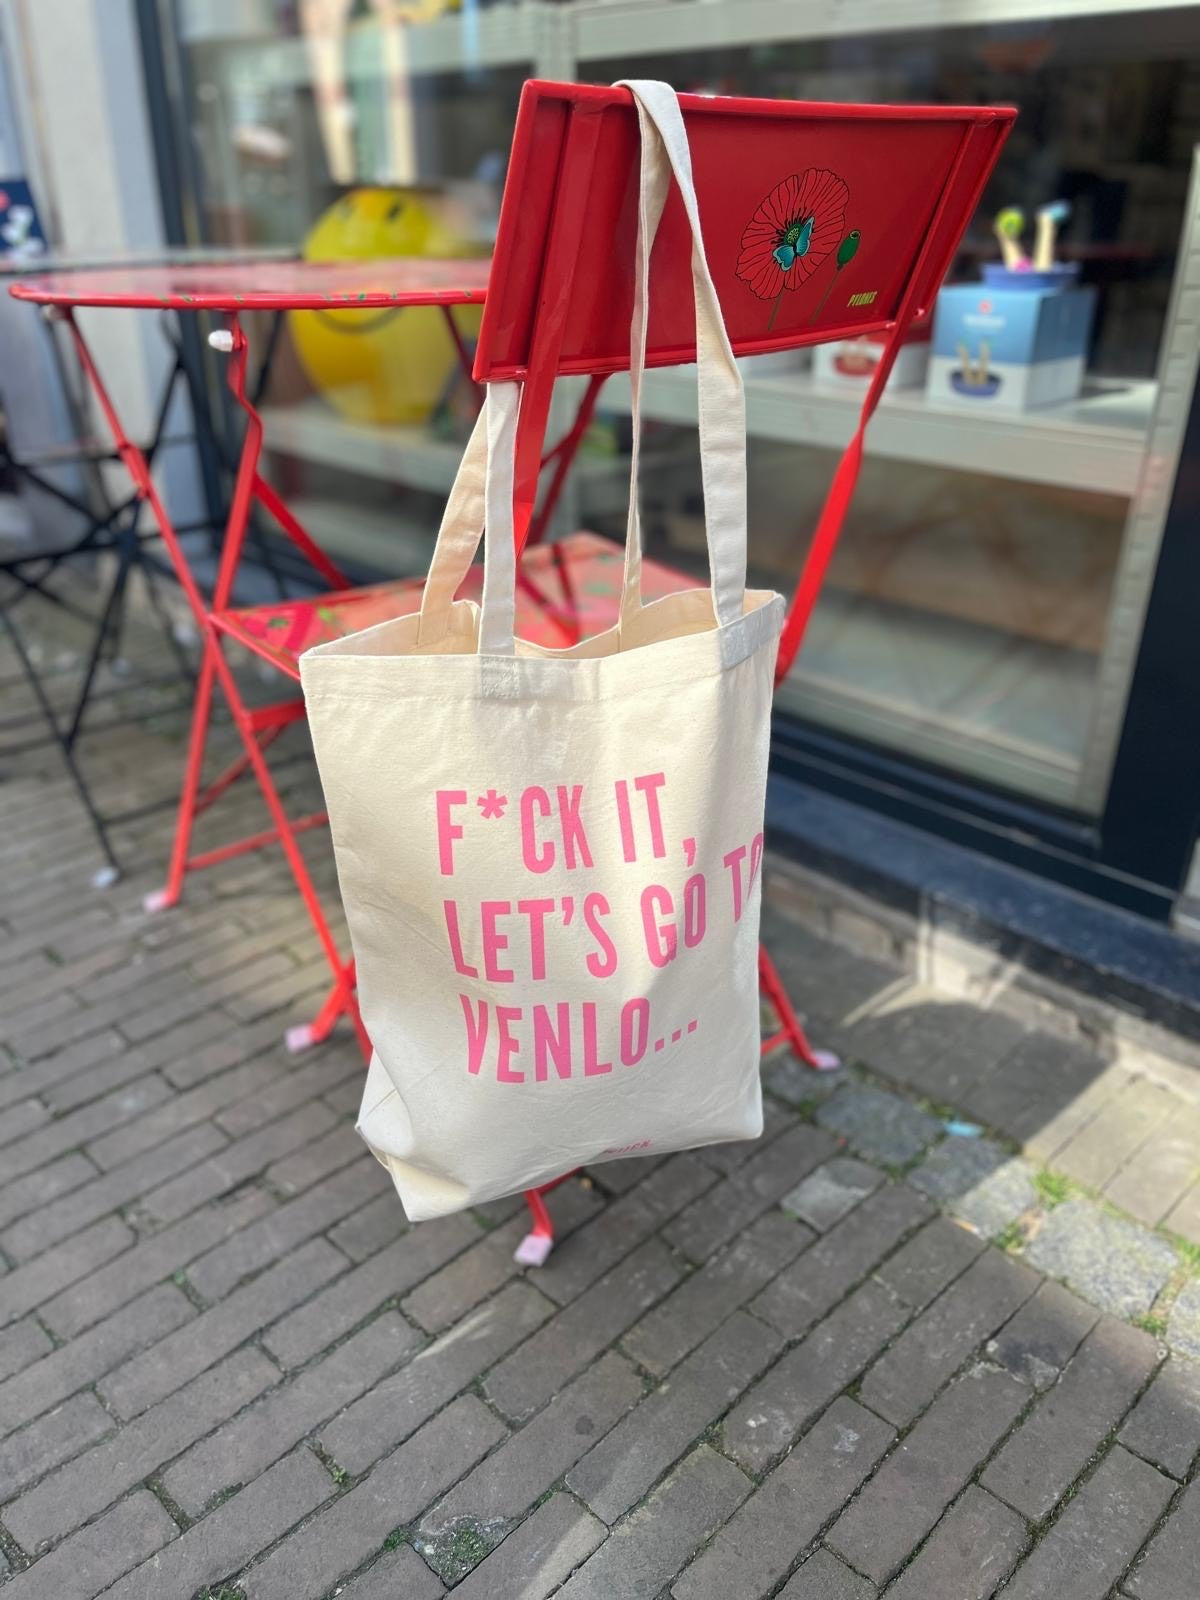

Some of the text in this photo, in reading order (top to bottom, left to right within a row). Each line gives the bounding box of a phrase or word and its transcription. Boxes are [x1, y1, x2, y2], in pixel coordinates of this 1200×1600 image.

[615, 772, 697, 868] IT,
[443, 892, 618, 983] LET’S
[640, 873, 707, 968] GO
[459, 993, 698, 1084] VENLO...
